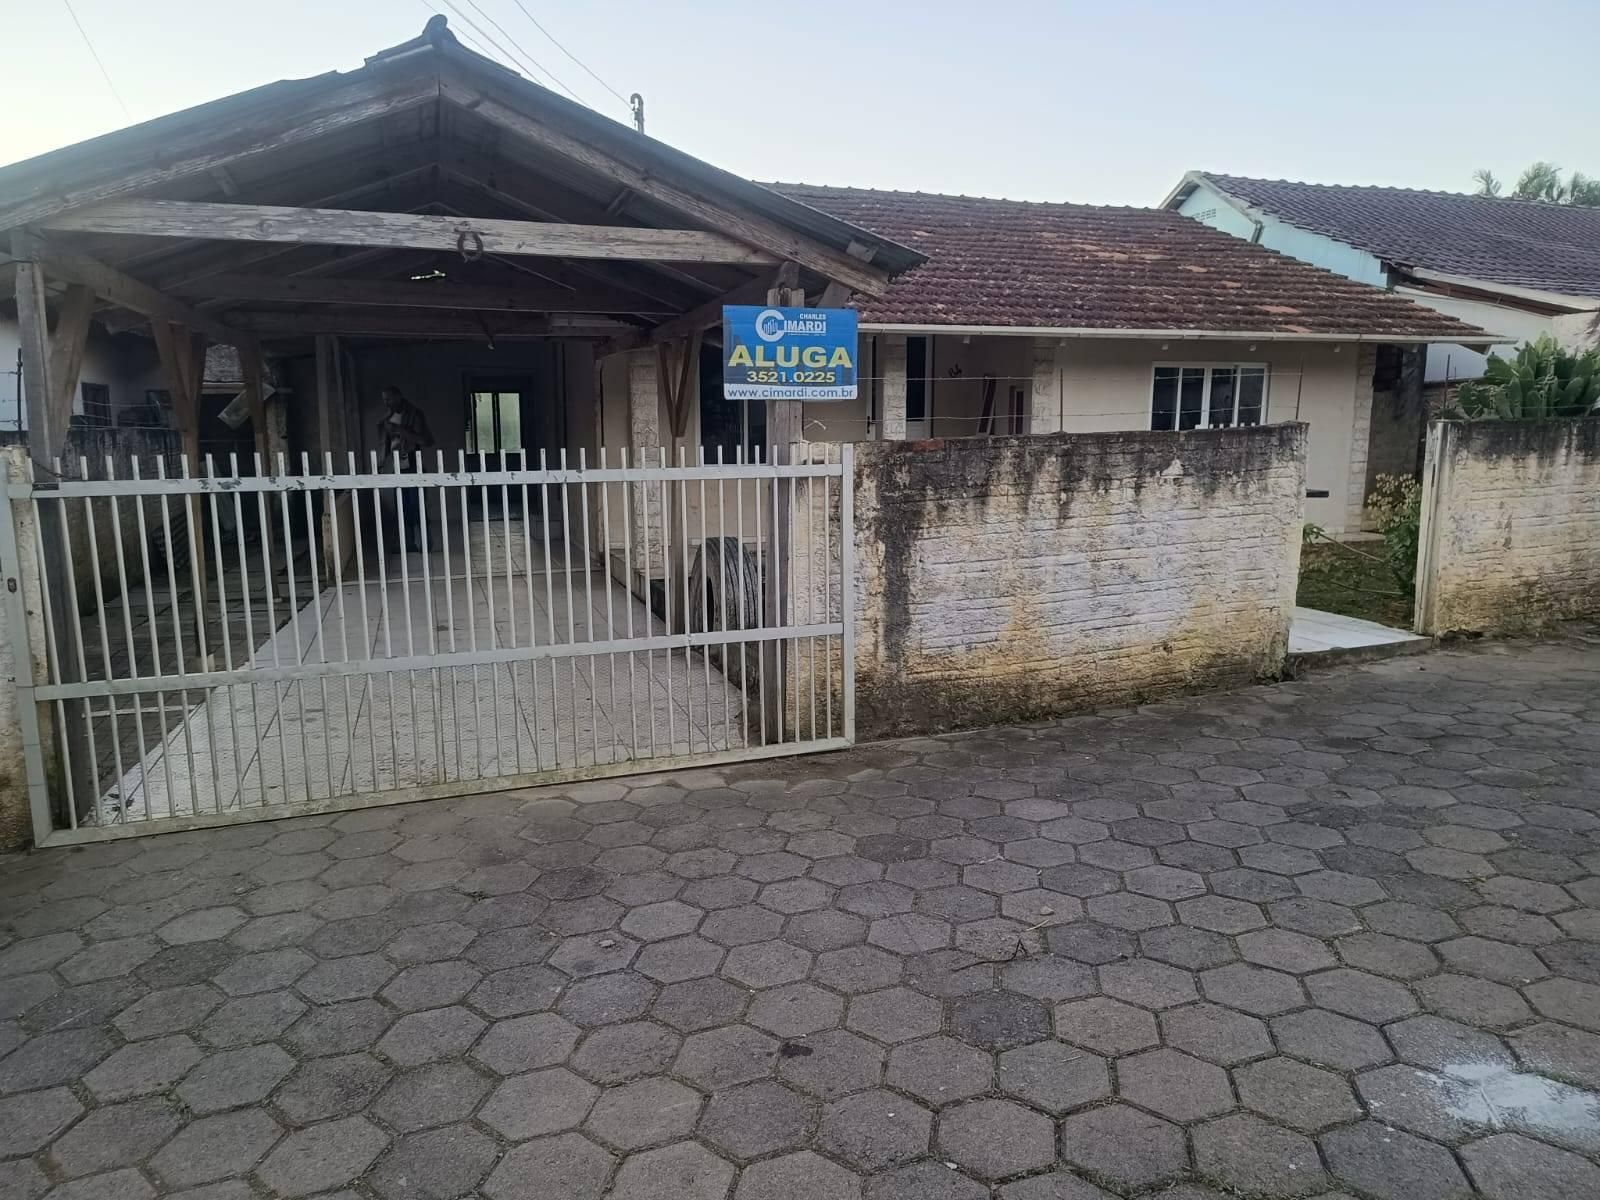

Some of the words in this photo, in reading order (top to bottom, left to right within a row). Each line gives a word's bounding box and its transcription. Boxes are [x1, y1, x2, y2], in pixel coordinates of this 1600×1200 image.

[728, 345, 852, 368] ALUGA
[746, 371, 836, 383] 3521.0225
[728, 387, 853, 398] www.cimardi.com.br
